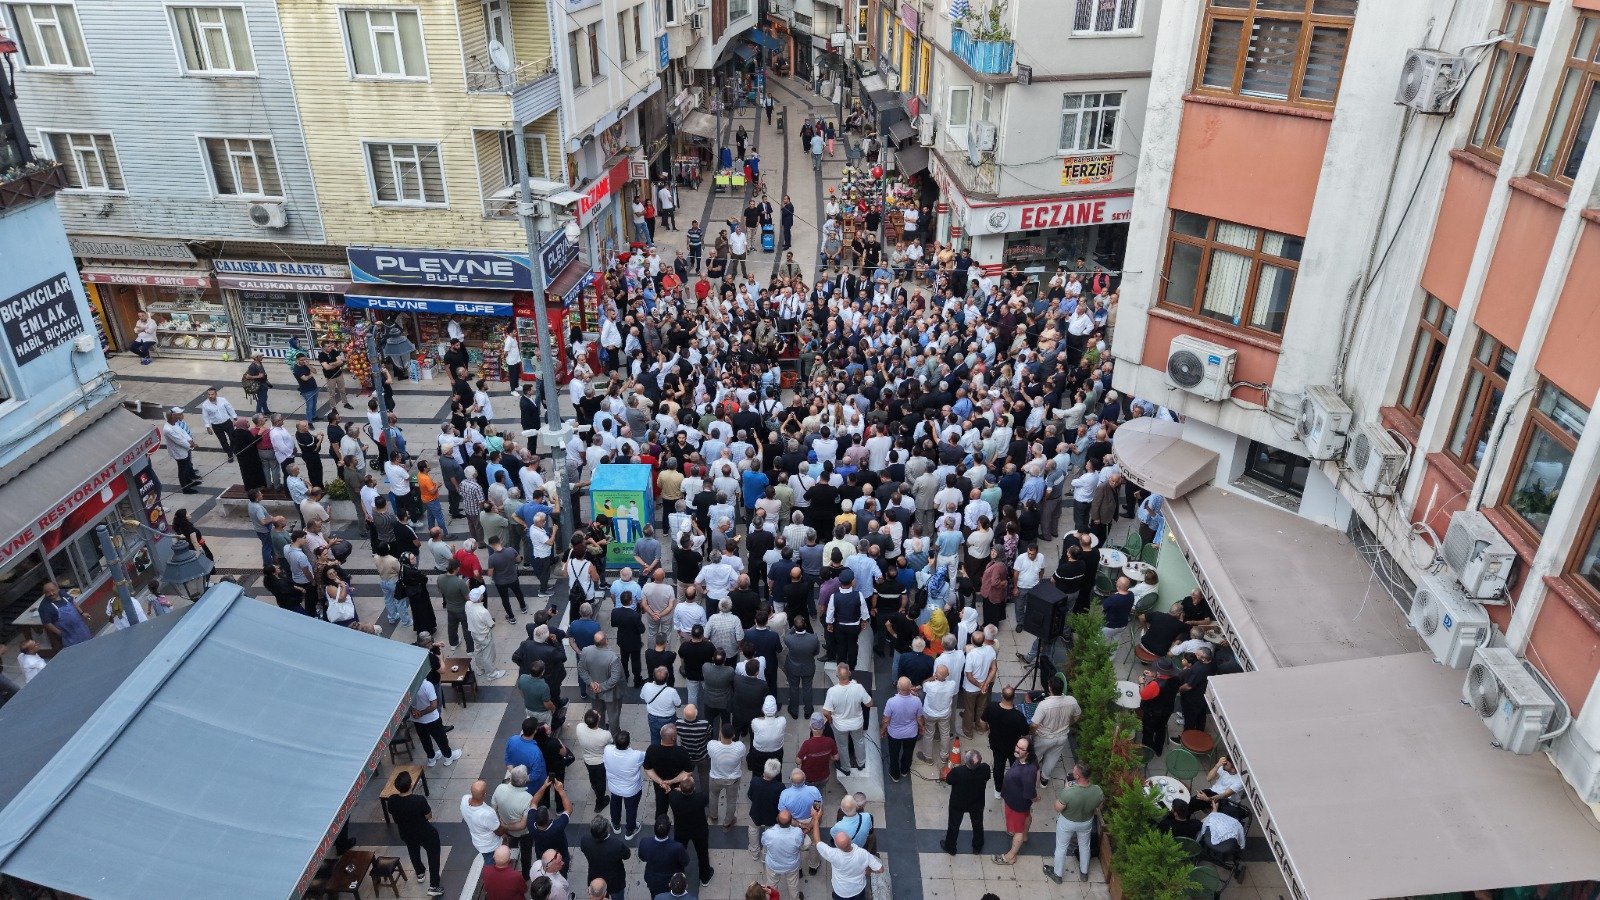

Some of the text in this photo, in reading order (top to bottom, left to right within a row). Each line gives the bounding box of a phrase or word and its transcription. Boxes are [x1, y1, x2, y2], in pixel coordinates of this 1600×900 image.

[1020, 201, 1106, 229] ECZANE
[375, 256, 514, 277] PLEVNE
[426, 273, 469, 283] BÜFE
[368, 299, 495, 314] PLEVNE BÜFE
[19, 302, 67, 338] EMLAK
[15, 334, 44, 357] HABİL
[37, 462, 118, 531] RESTORANT
[1191, 561, 1226, 627] PLEVNE
